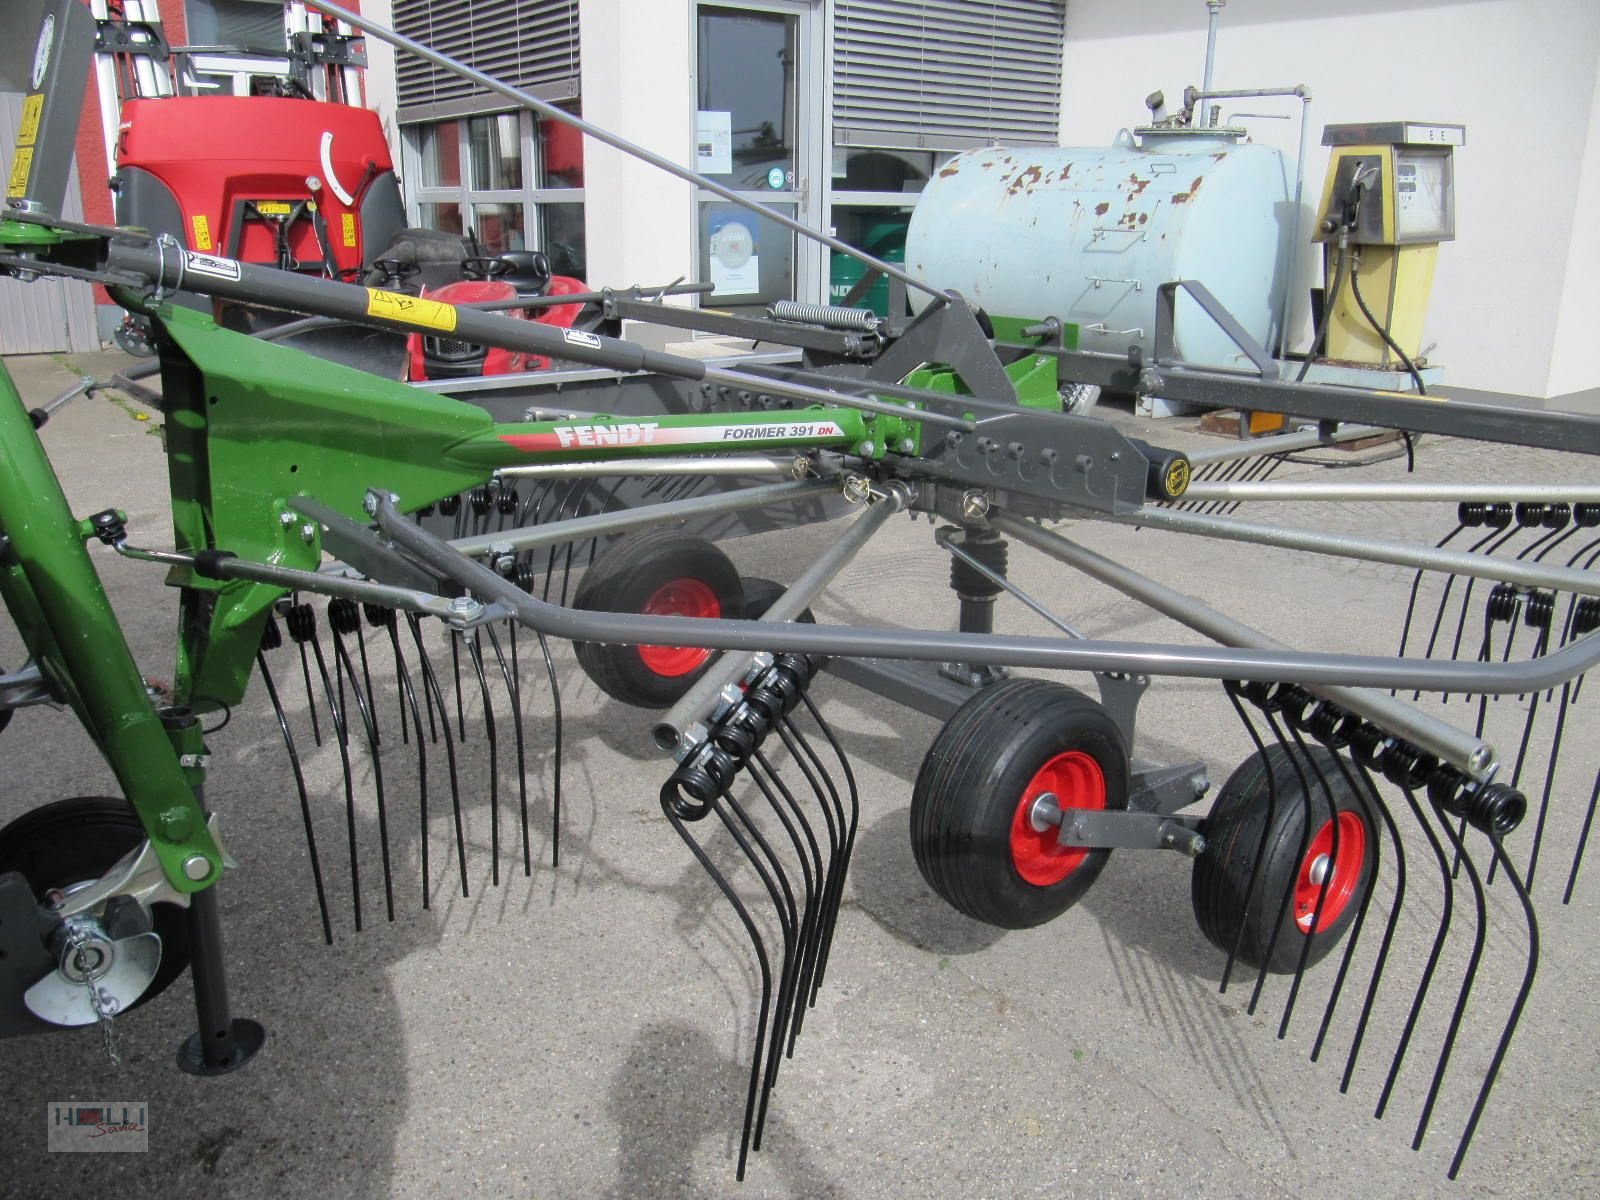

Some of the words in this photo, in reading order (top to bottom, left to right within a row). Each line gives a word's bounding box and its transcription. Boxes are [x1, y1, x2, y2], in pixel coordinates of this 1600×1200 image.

[553, 423, 659, 447] FENDT
[723, 427, 786, 439] FORMER
[789, 426, 814, 437] 391
[817, 427, 834, 435] DN
